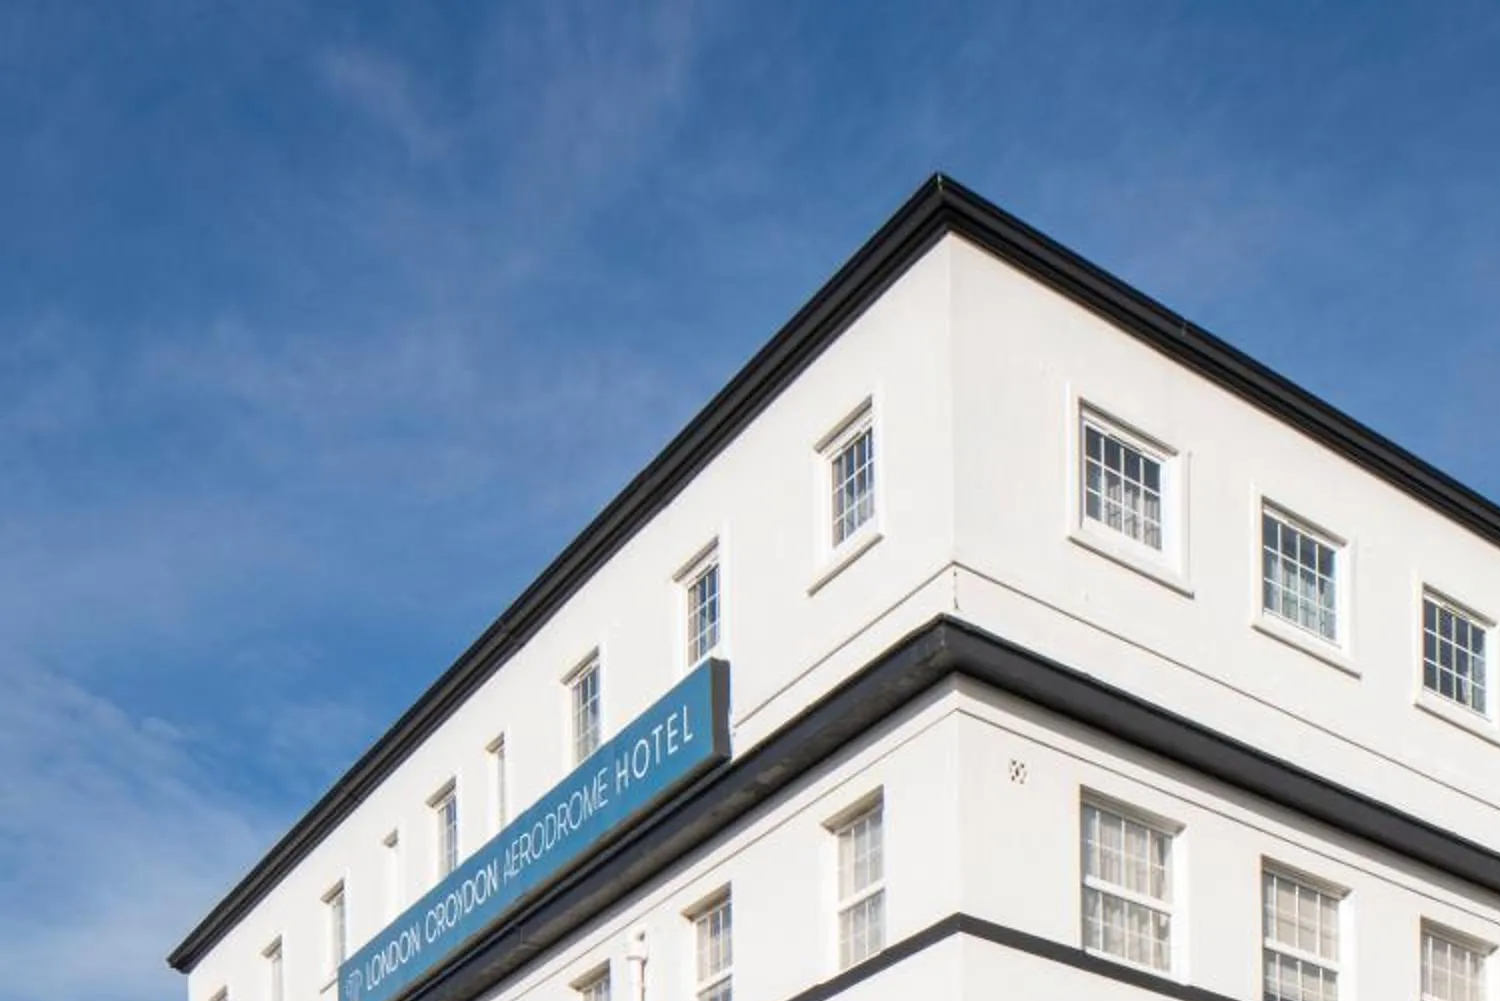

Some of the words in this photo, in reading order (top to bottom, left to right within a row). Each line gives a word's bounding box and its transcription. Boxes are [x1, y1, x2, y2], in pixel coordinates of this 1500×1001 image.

[365, 921, 421, 991] LONDON
[425, 858, 498, 944] CROYDON
[503, 766, 609, 887] AERODROME
[615, 704, 694, 794] HOTEL
